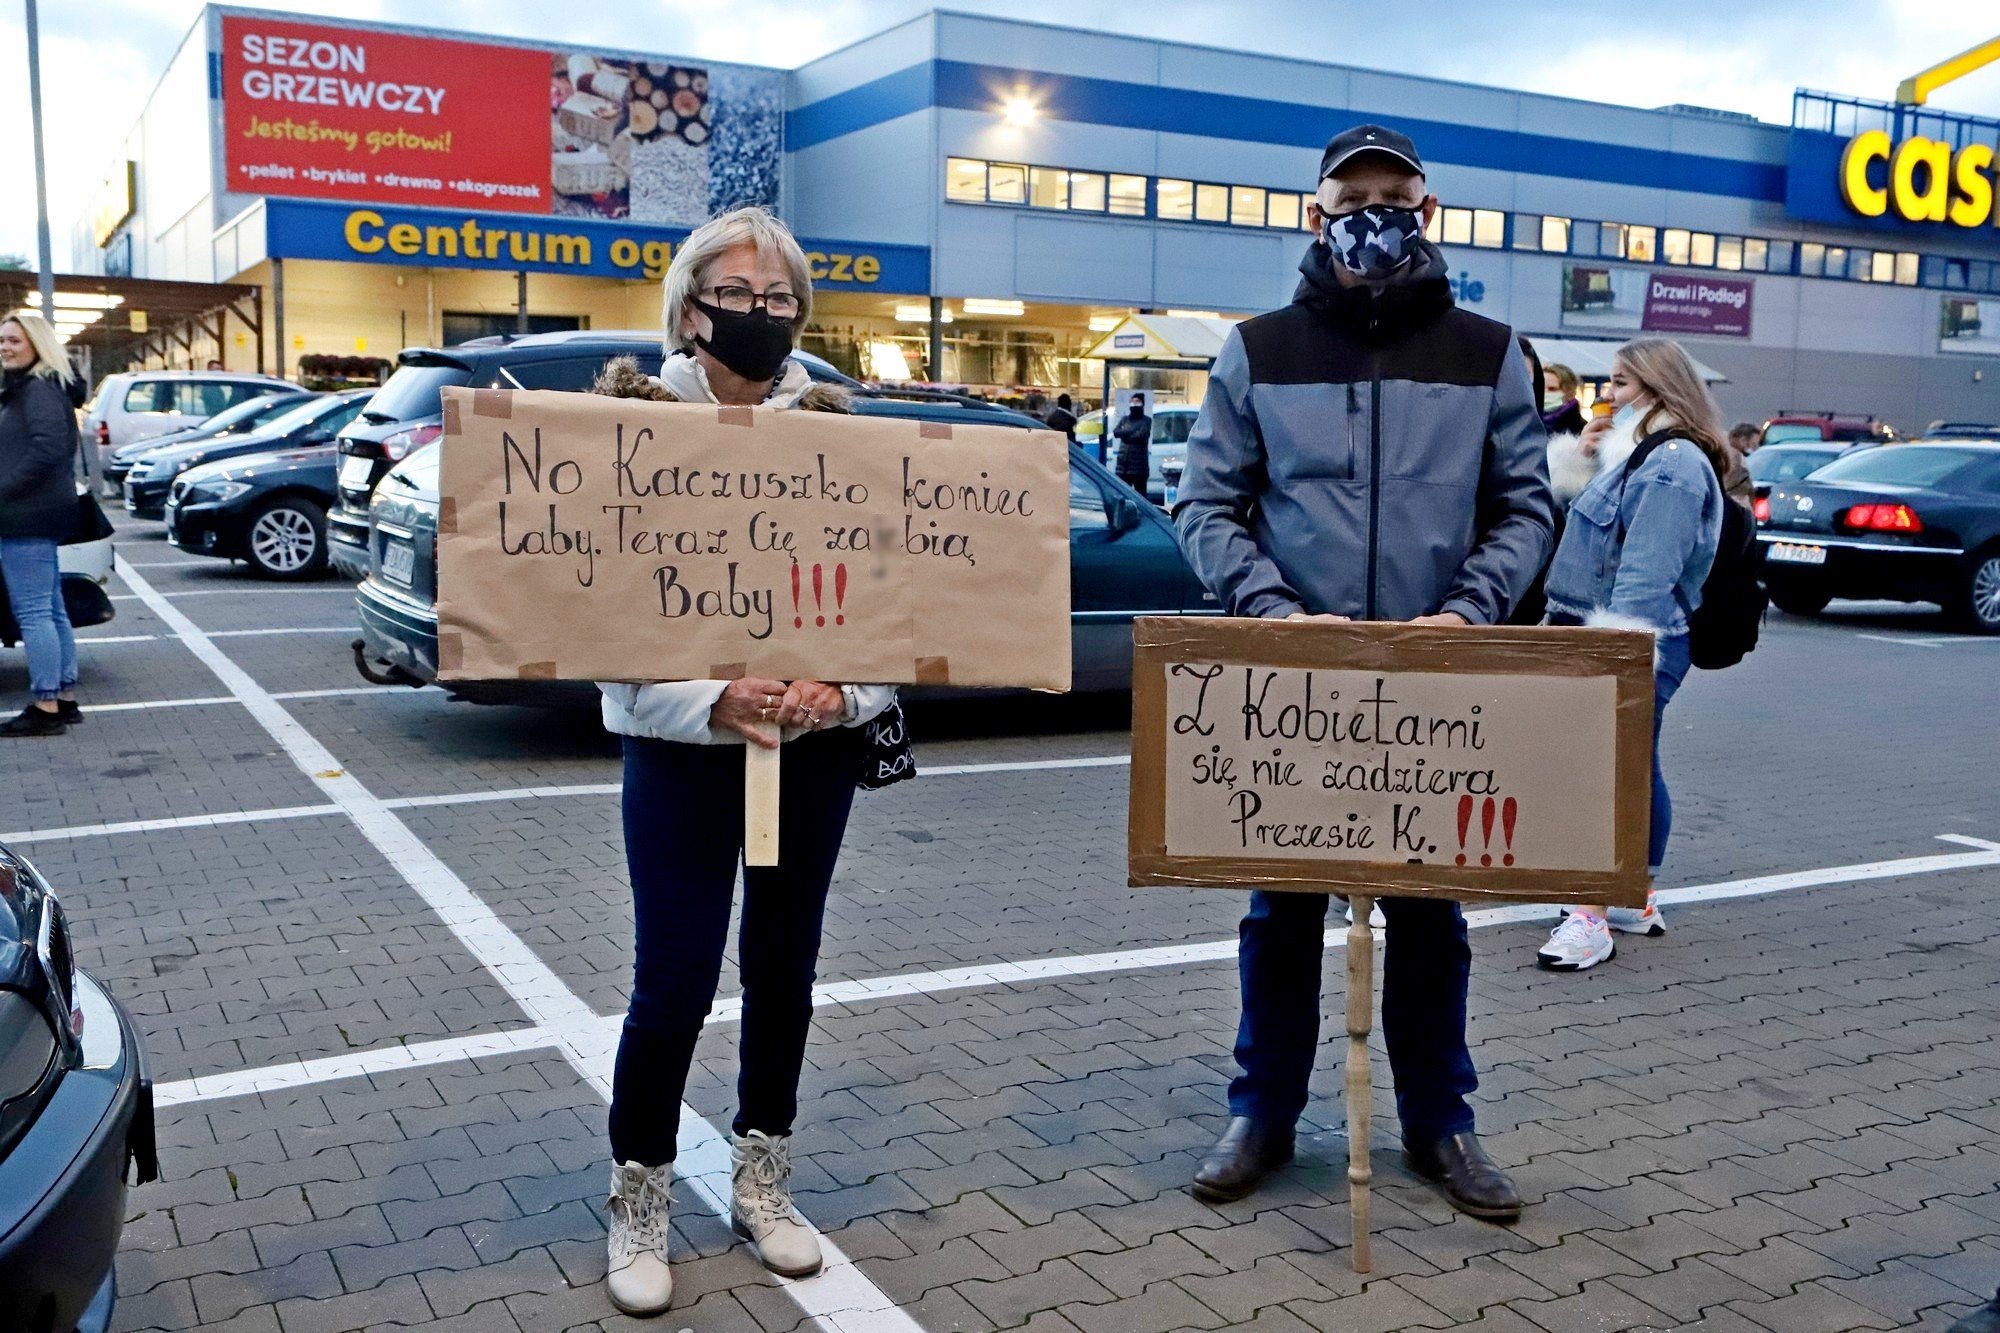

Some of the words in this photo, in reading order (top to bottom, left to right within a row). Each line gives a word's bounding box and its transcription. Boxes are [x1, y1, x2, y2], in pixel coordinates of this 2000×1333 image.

[242, 34, 365, 73] SEZON
[242, 70, 446, 116] GRZEWCZY
[244, 116, 358, 151] Jesteśmy
[366, 128, 452, 154] gotowi!
[249, 163, 295, 180] pellet
[310, 167, 366, 187] brykiet
[383, 173, 442, 190] drewno
[457, 178, 541, 199] ekogroszek
[1840, 130, 2000, 229] cas
[344, 210, 592, 266] Centrum
[1652, 282, 1691, 301] Drzwi
[502, 427, 583, 494] No
[612, 423, 869, 504] Kaczuszko
[749, 511, 798, 564] Cię
[1171, 663, 1224, 737] Z
[1242, 667, 1486, 750] Kobietami
[1192, 745, 1238, 789] się
[1253, 748, 1303, 787] nie
[1322, 751, 1500, 795] zadziera
[1228, 790, 1375, 849] Prezesie
